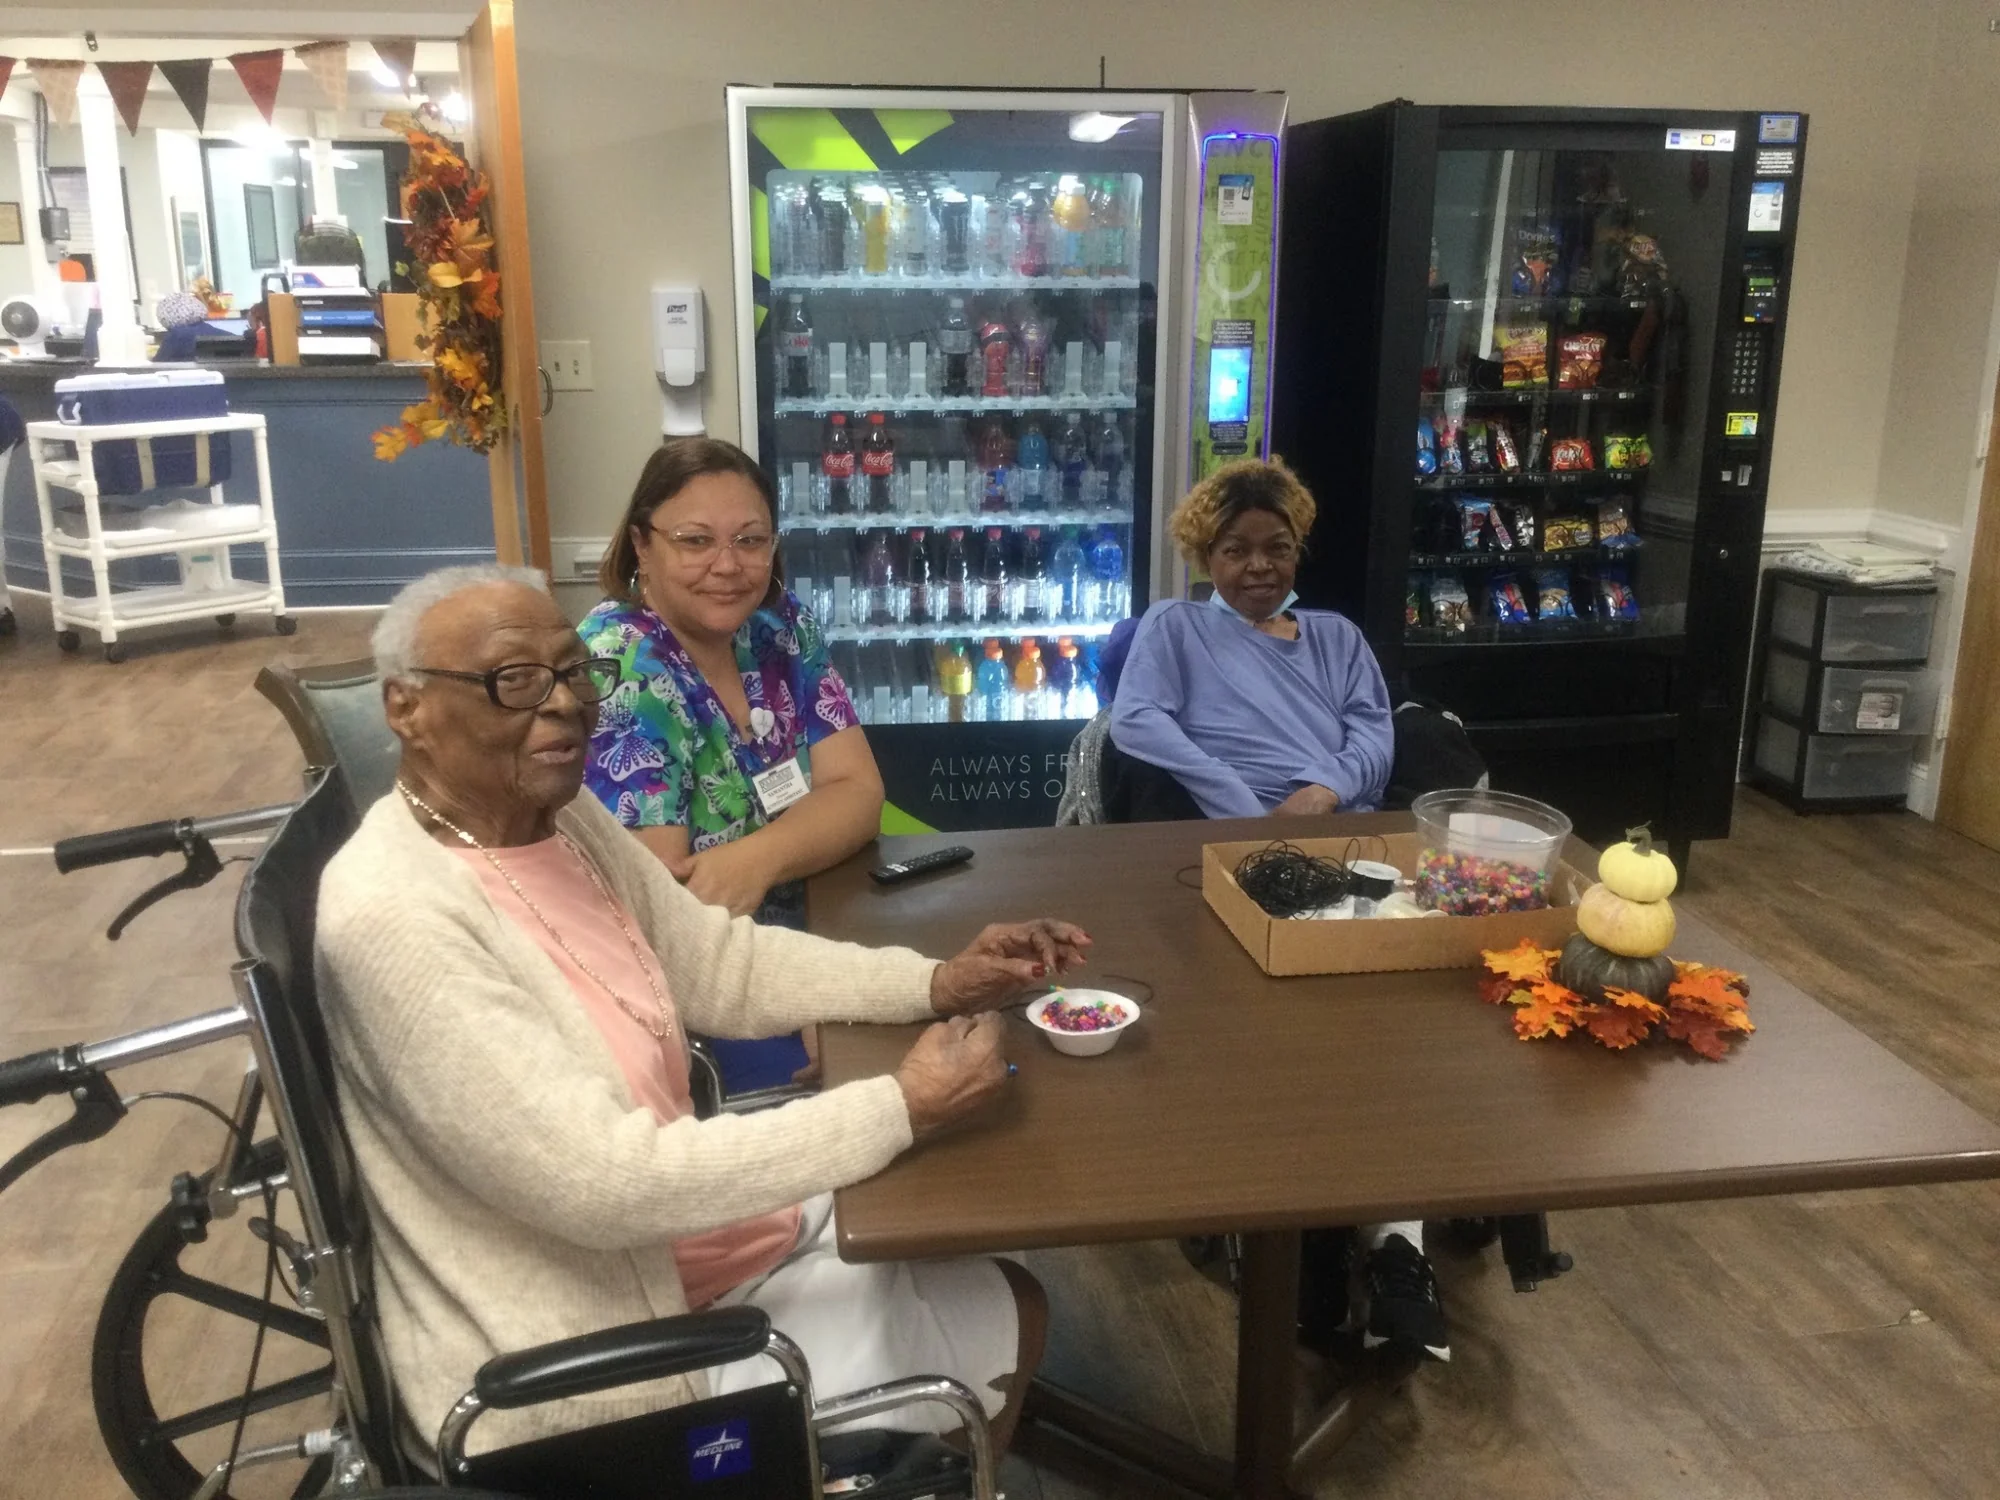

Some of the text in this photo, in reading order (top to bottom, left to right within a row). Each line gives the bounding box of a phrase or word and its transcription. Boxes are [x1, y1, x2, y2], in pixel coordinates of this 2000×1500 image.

[930, 754, 1031, 776] ALWAYS
[930, 780, 1031, 801] ALWAYS
[693, 1440, 744, 1459] MEDLINE
